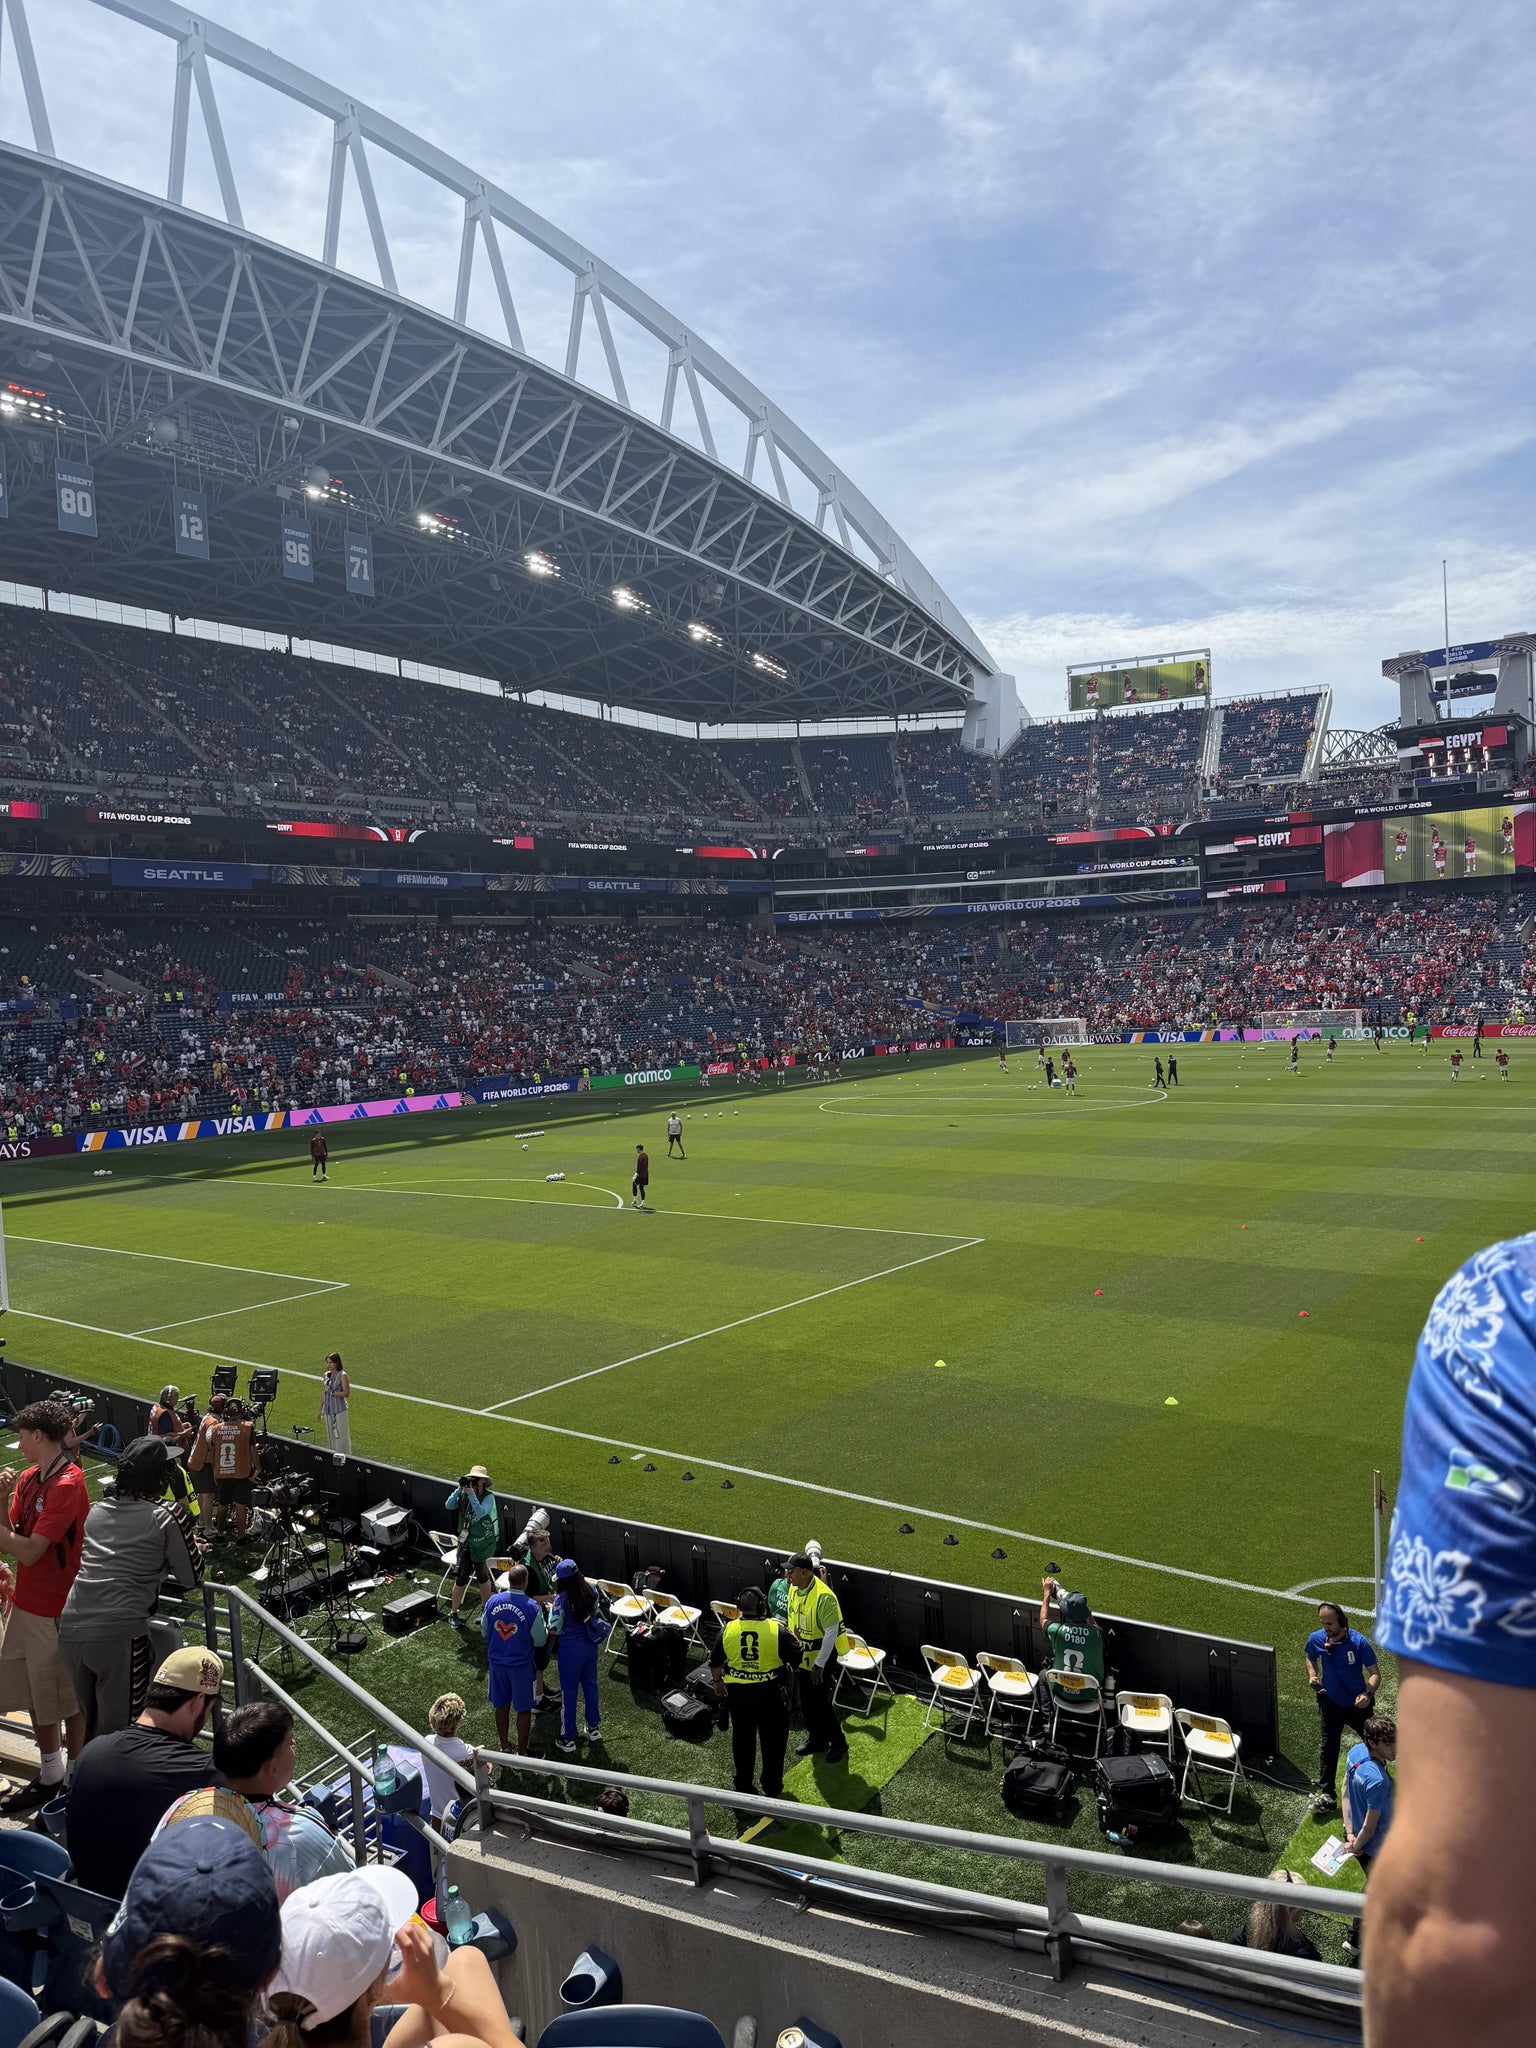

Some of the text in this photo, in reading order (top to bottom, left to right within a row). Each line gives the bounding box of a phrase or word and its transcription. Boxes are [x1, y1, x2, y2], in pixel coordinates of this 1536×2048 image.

[57, 472, 92, 486] LARGENT
[61, 488, 92, 518] 80
[180, 514, 204, 542] 12
[285, 540, 310, 566] 96
[350, 556, 370, 581] 71
[1446, 732, 1482, 749] EGYPT
[1514, 789, 1530, 797] EGYPT
[99, 812, 116, 820] FIFA
[117, 813, 146, 822] WORLD
[1258, 832, 1290, 846] EGYPT
[144, 868, 224, 882] SEATTLE
[397, 875, 448, 886] #FIFAWorldCup
[588, 881, 640, 890] SEATTLE
[1243, 884, 1264, 893] EGYPT
[968, 898, 1080, 913] FIFA WORLD CUP 2026
[789, 911, 852, 922] SEATTLE
[232, 994, 251, 1002] FIFA
[1043, 1036, 1074, 1045] QATAR
[1080, 1034, 1121, 1044] AIRWAYS
[1157, 1032, 1186, 1043] VISA
[707, 1063, 729, 1074] Coca-Cola
[624, 1069, 672, 1085] aramco
[483, 1083, 568, 1100] FIFA WORLD CUP 2026
[212, 1116, 256, 1135] VISA
[118, 1125, 168, 1146] VISA
[491, 1603, 525, 1622] VOLUNTEER
[1065, 1633, 1086, 1644] 0180
[730, 1669, 776, 1680] SECURITY
